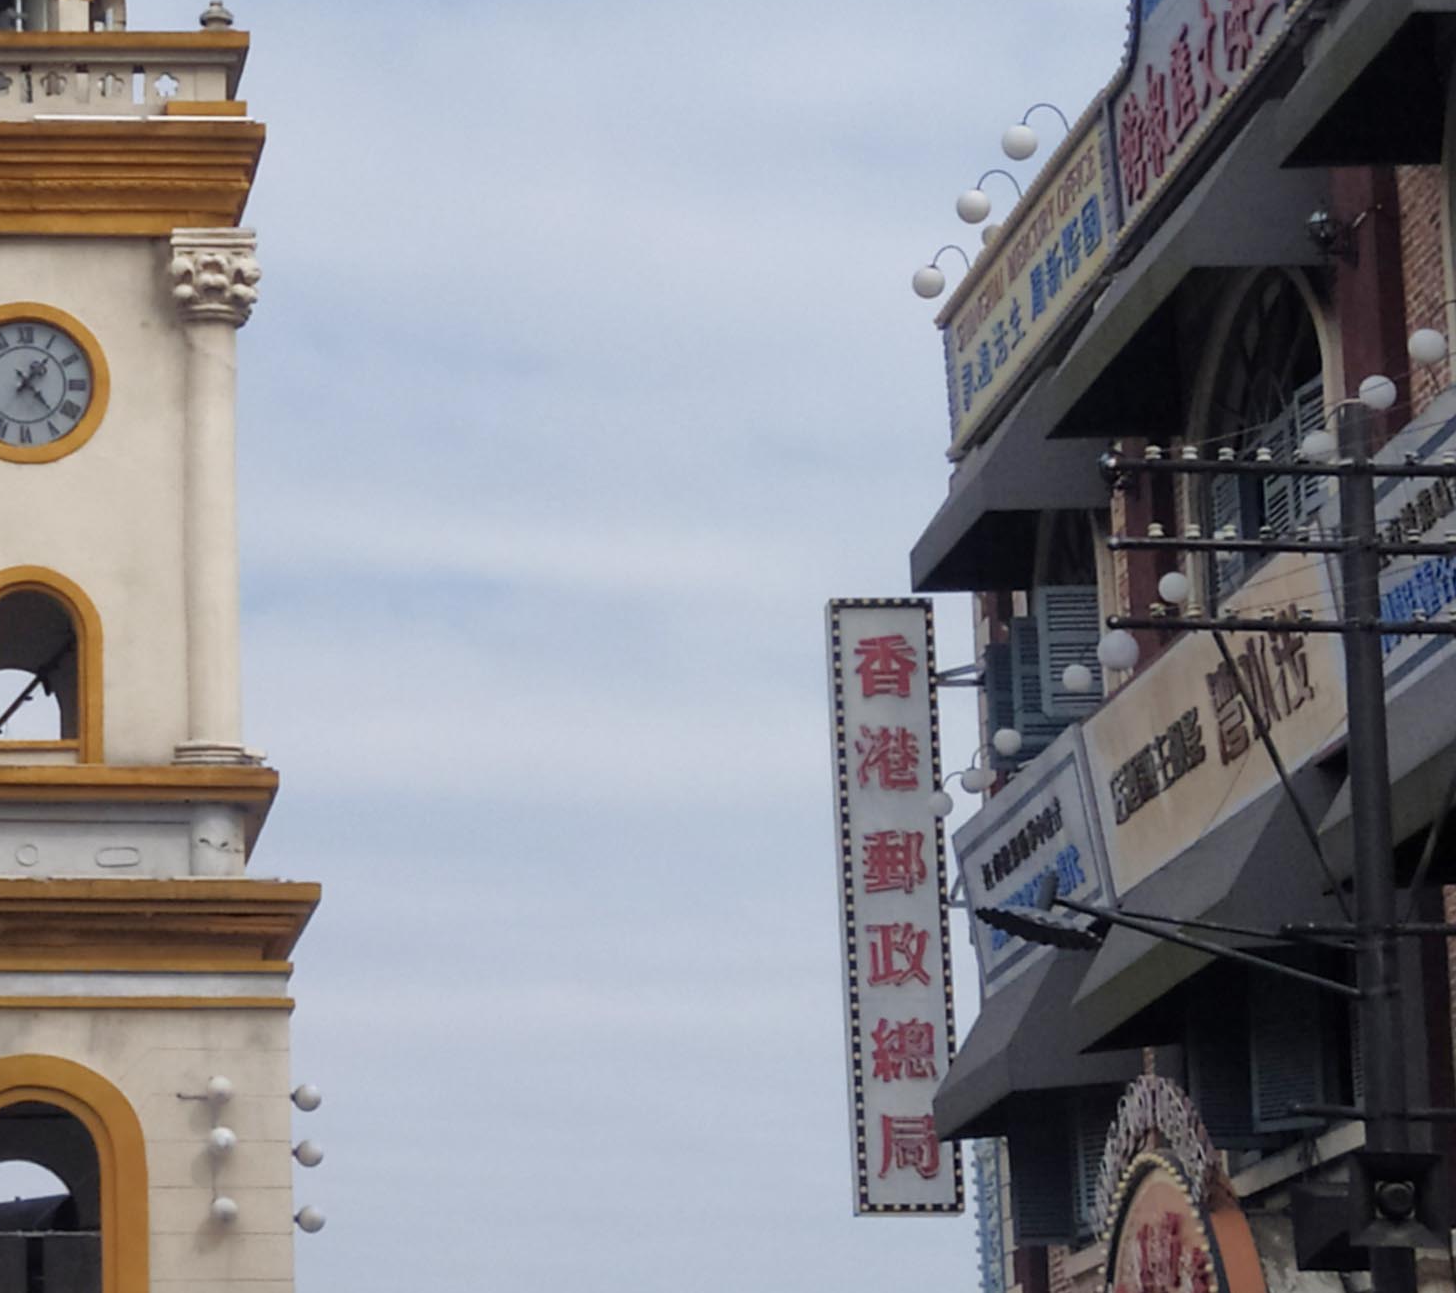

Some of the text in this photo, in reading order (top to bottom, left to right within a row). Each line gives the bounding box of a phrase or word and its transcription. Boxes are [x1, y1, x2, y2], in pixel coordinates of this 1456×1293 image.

[853, 634, 941, 1180] 香港郵政總局
